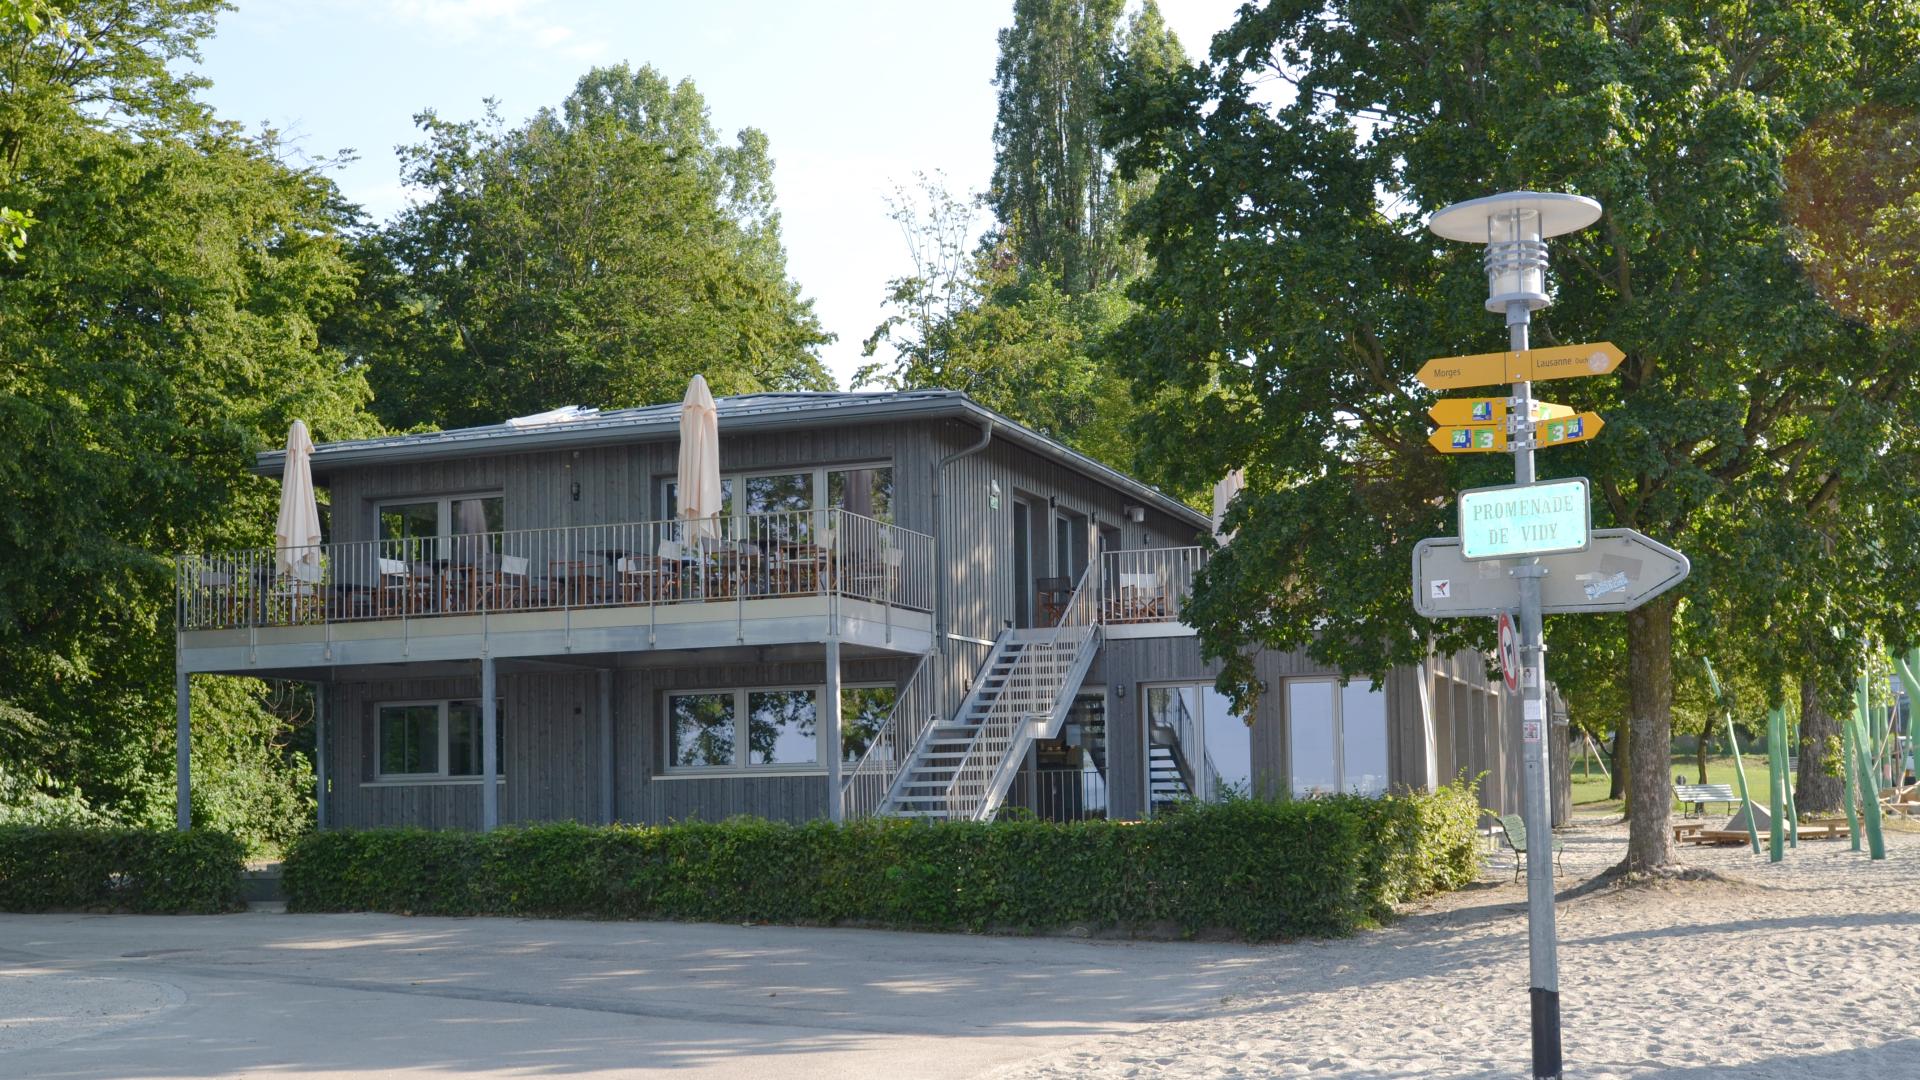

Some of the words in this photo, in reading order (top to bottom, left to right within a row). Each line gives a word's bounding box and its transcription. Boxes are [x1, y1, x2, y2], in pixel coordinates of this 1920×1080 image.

[1536, 358, 1572, 368] Lausanne
[1434, 369, 1461, 378] Morges
[1473, 403, 1484, 415] 4
[1480, 432, 1494, 448] 3
[1553, 425, 1564, 442] 3
[1473, 495, 1574, 521] PROMENADE
[1489, 528, 1509, 545] DE
[1522, 523, 1558, 543] VIDY
